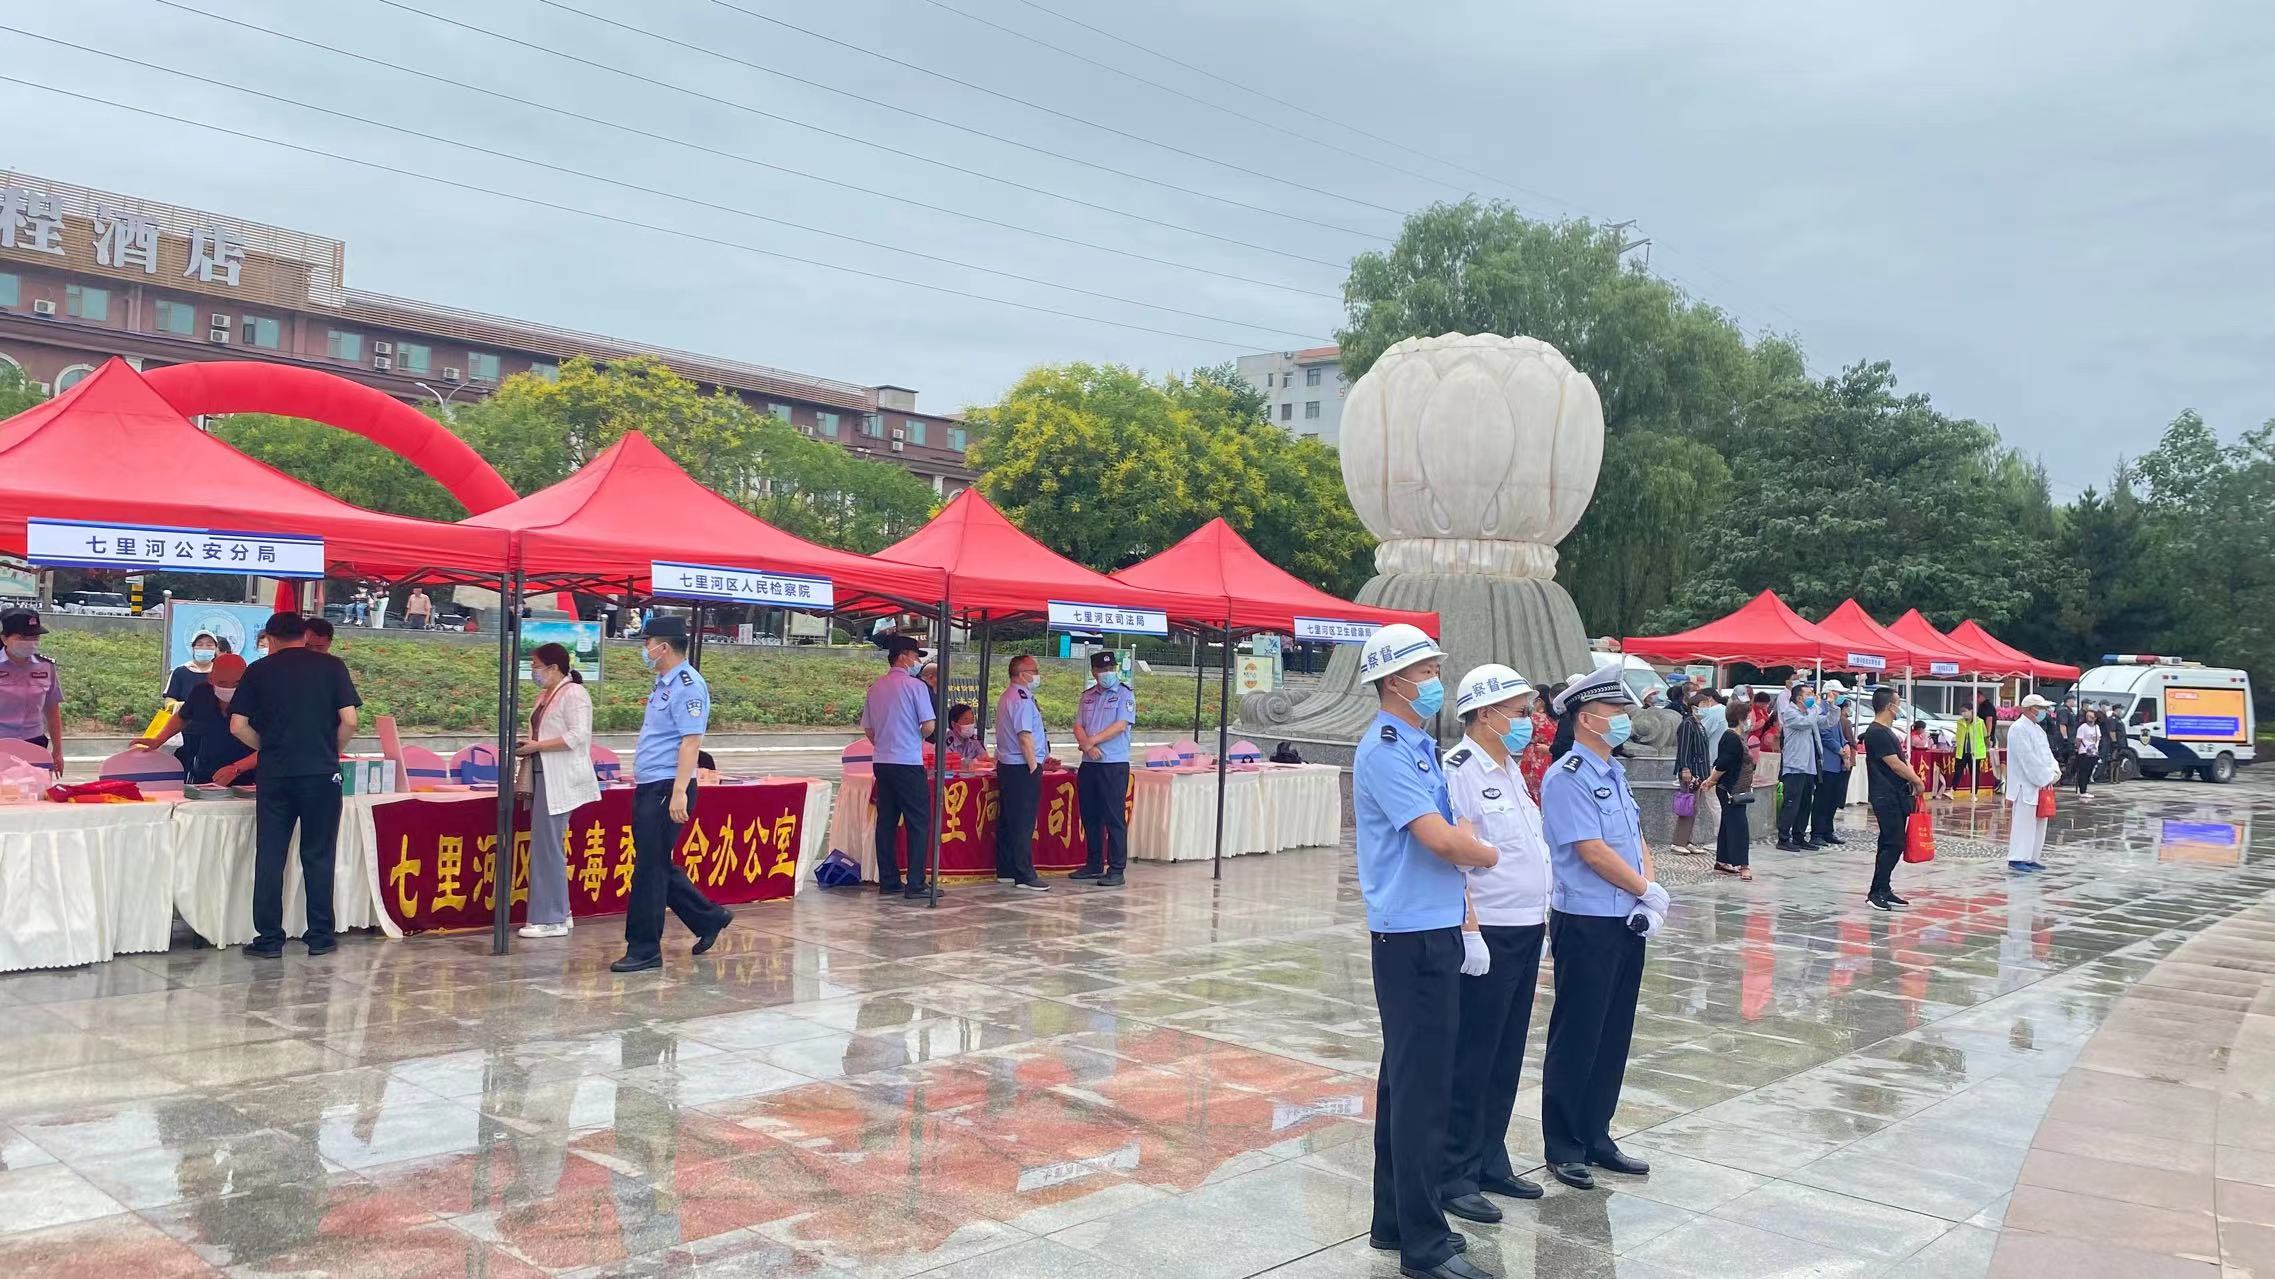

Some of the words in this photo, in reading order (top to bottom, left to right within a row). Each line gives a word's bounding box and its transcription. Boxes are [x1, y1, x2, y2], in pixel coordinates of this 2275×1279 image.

[0, 186, 246, 287] 程酒店
[85, 535, 276, 563] 七里河公安分局
[679, 573, 811, 598] 七里河区人民检察院
[1073, 610, 1145, 627] 七里河区司法局
[1307, 624, 1372, 637] 七里河区卫生健康局
[390, 807, 797, 918] 七里河区毒委会办公室
